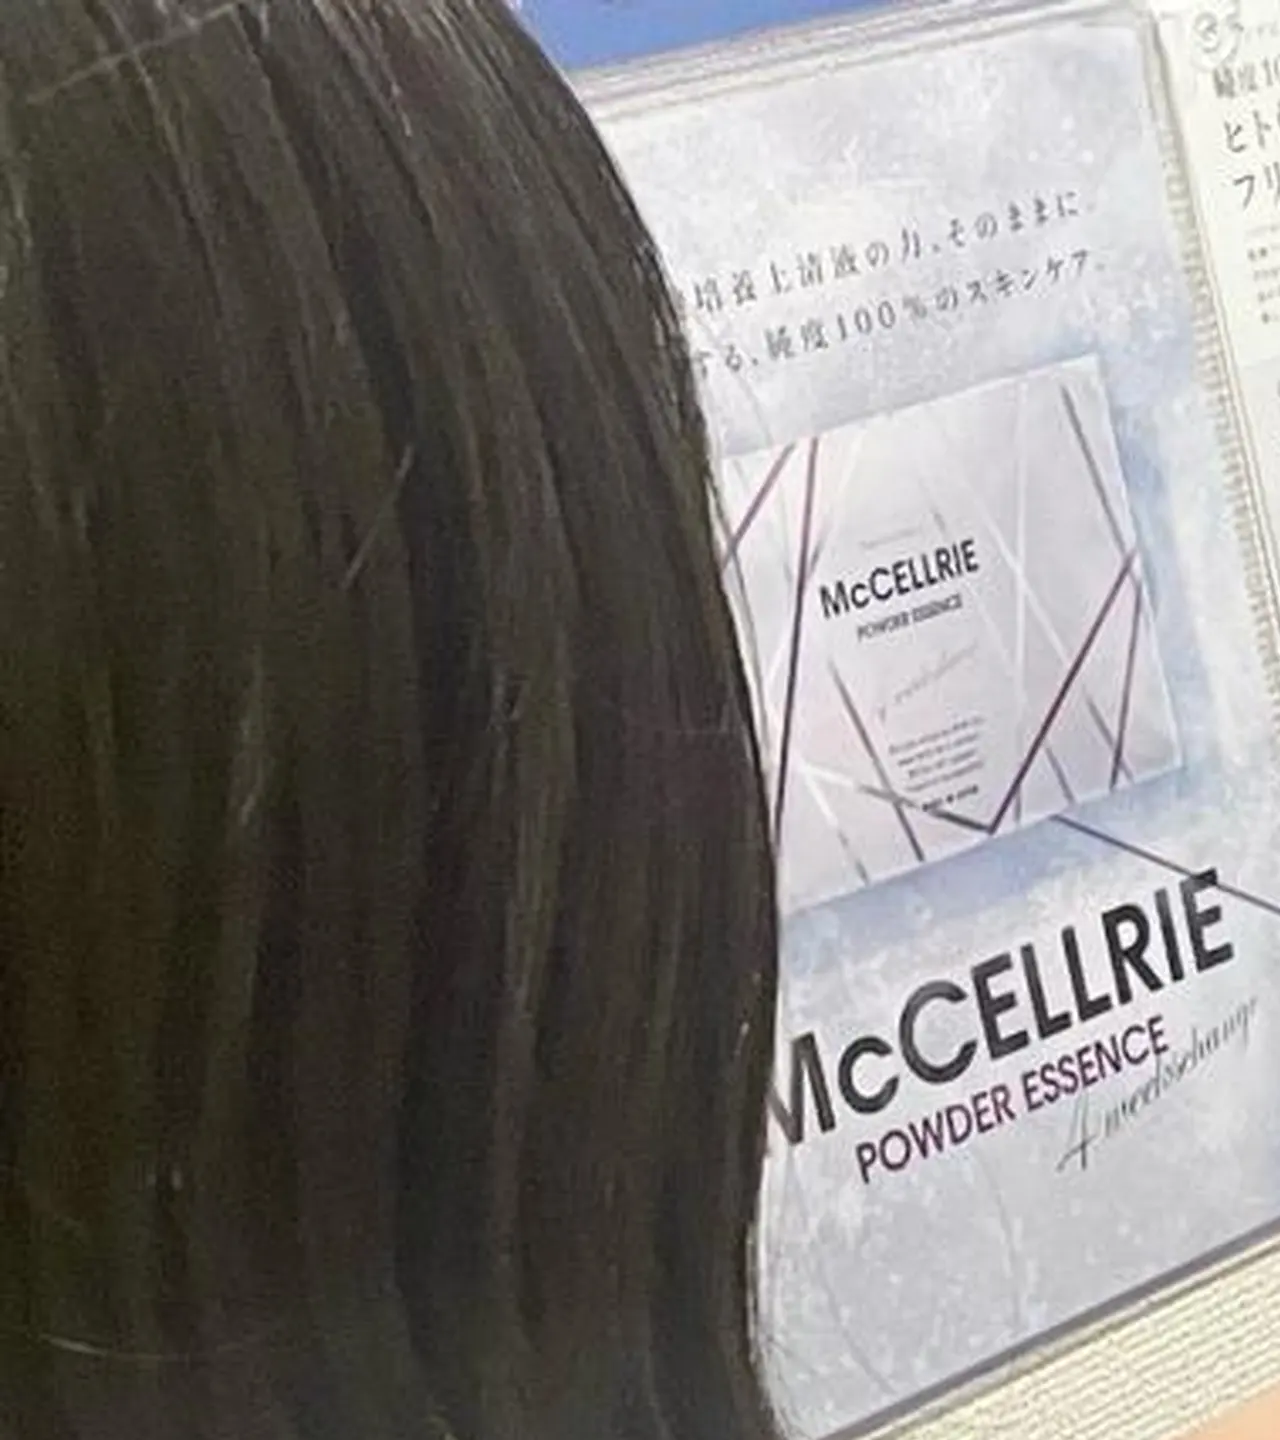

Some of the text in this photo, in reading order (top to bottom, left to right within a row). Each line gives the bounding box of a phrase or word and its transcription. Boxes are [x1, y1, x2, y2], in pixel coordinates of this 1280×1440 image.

[819, 538, 979, 619] McCELLRIE
[766, 868, 1235, 1147] McCELLRIE
[855, 1014, 1170, 1184] POWDER ESSENCE
